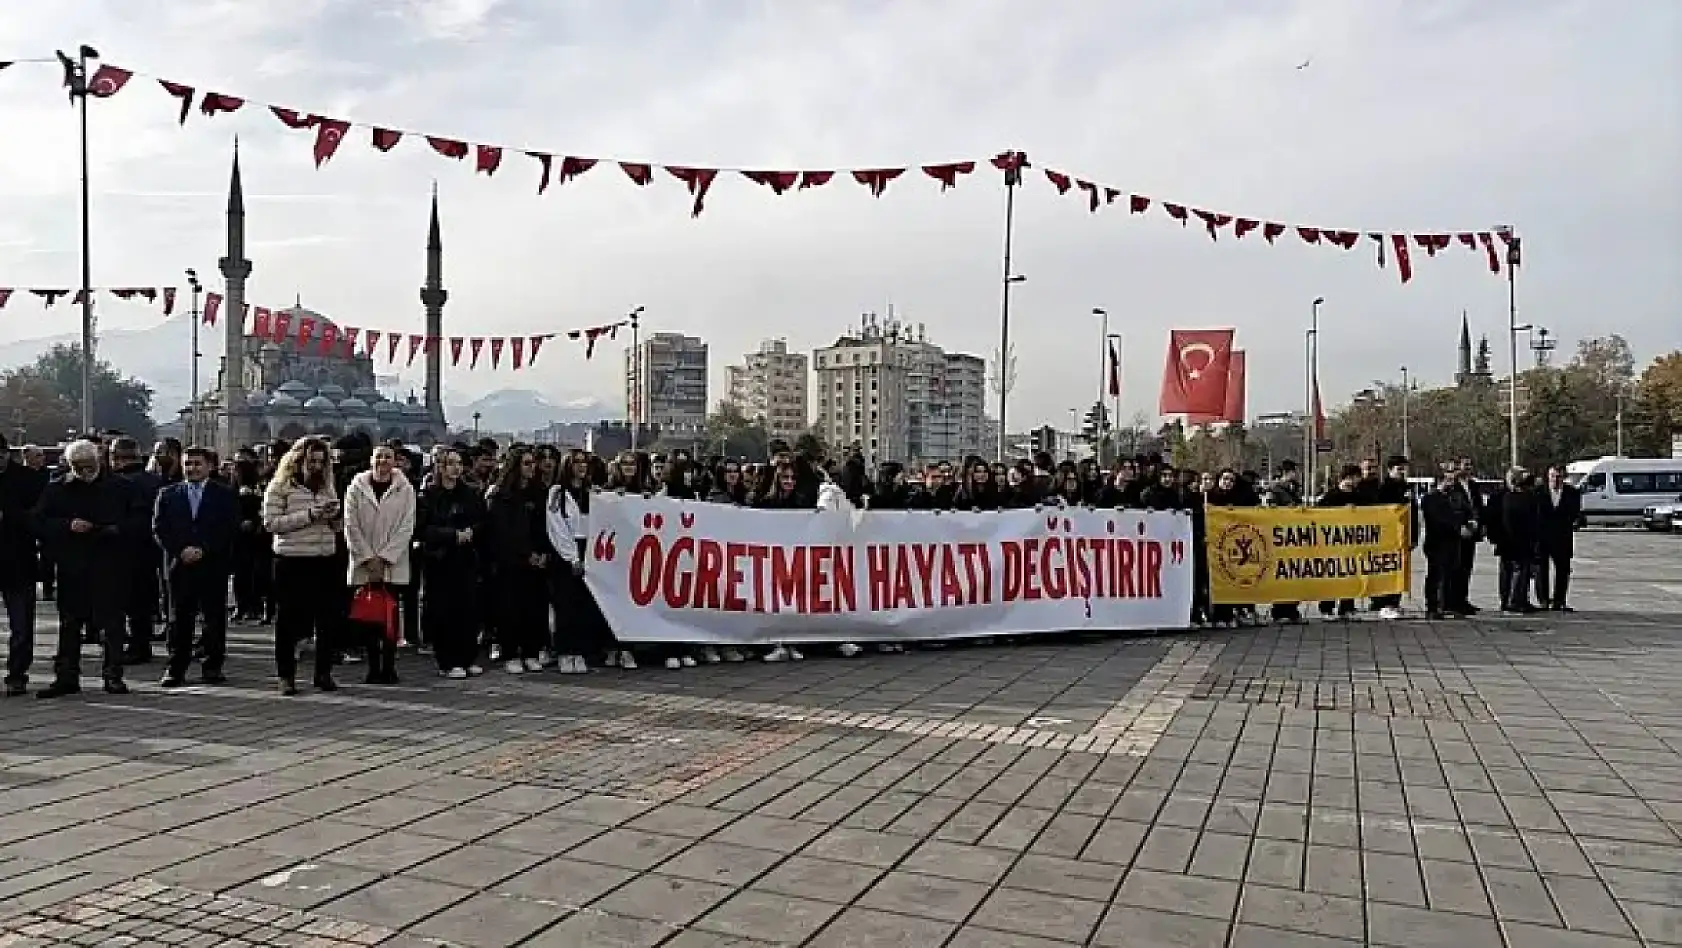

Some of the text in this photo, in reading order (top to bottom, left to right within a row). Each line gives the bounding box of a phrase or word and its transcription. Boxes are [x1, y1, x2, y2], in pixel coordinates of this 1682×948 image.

[1272, 521, 1380, 547] SAMİ YANGIN
[866, 543, 992, 611] HAYATI
[1275, 557, 1357, 579] ANADOLU
